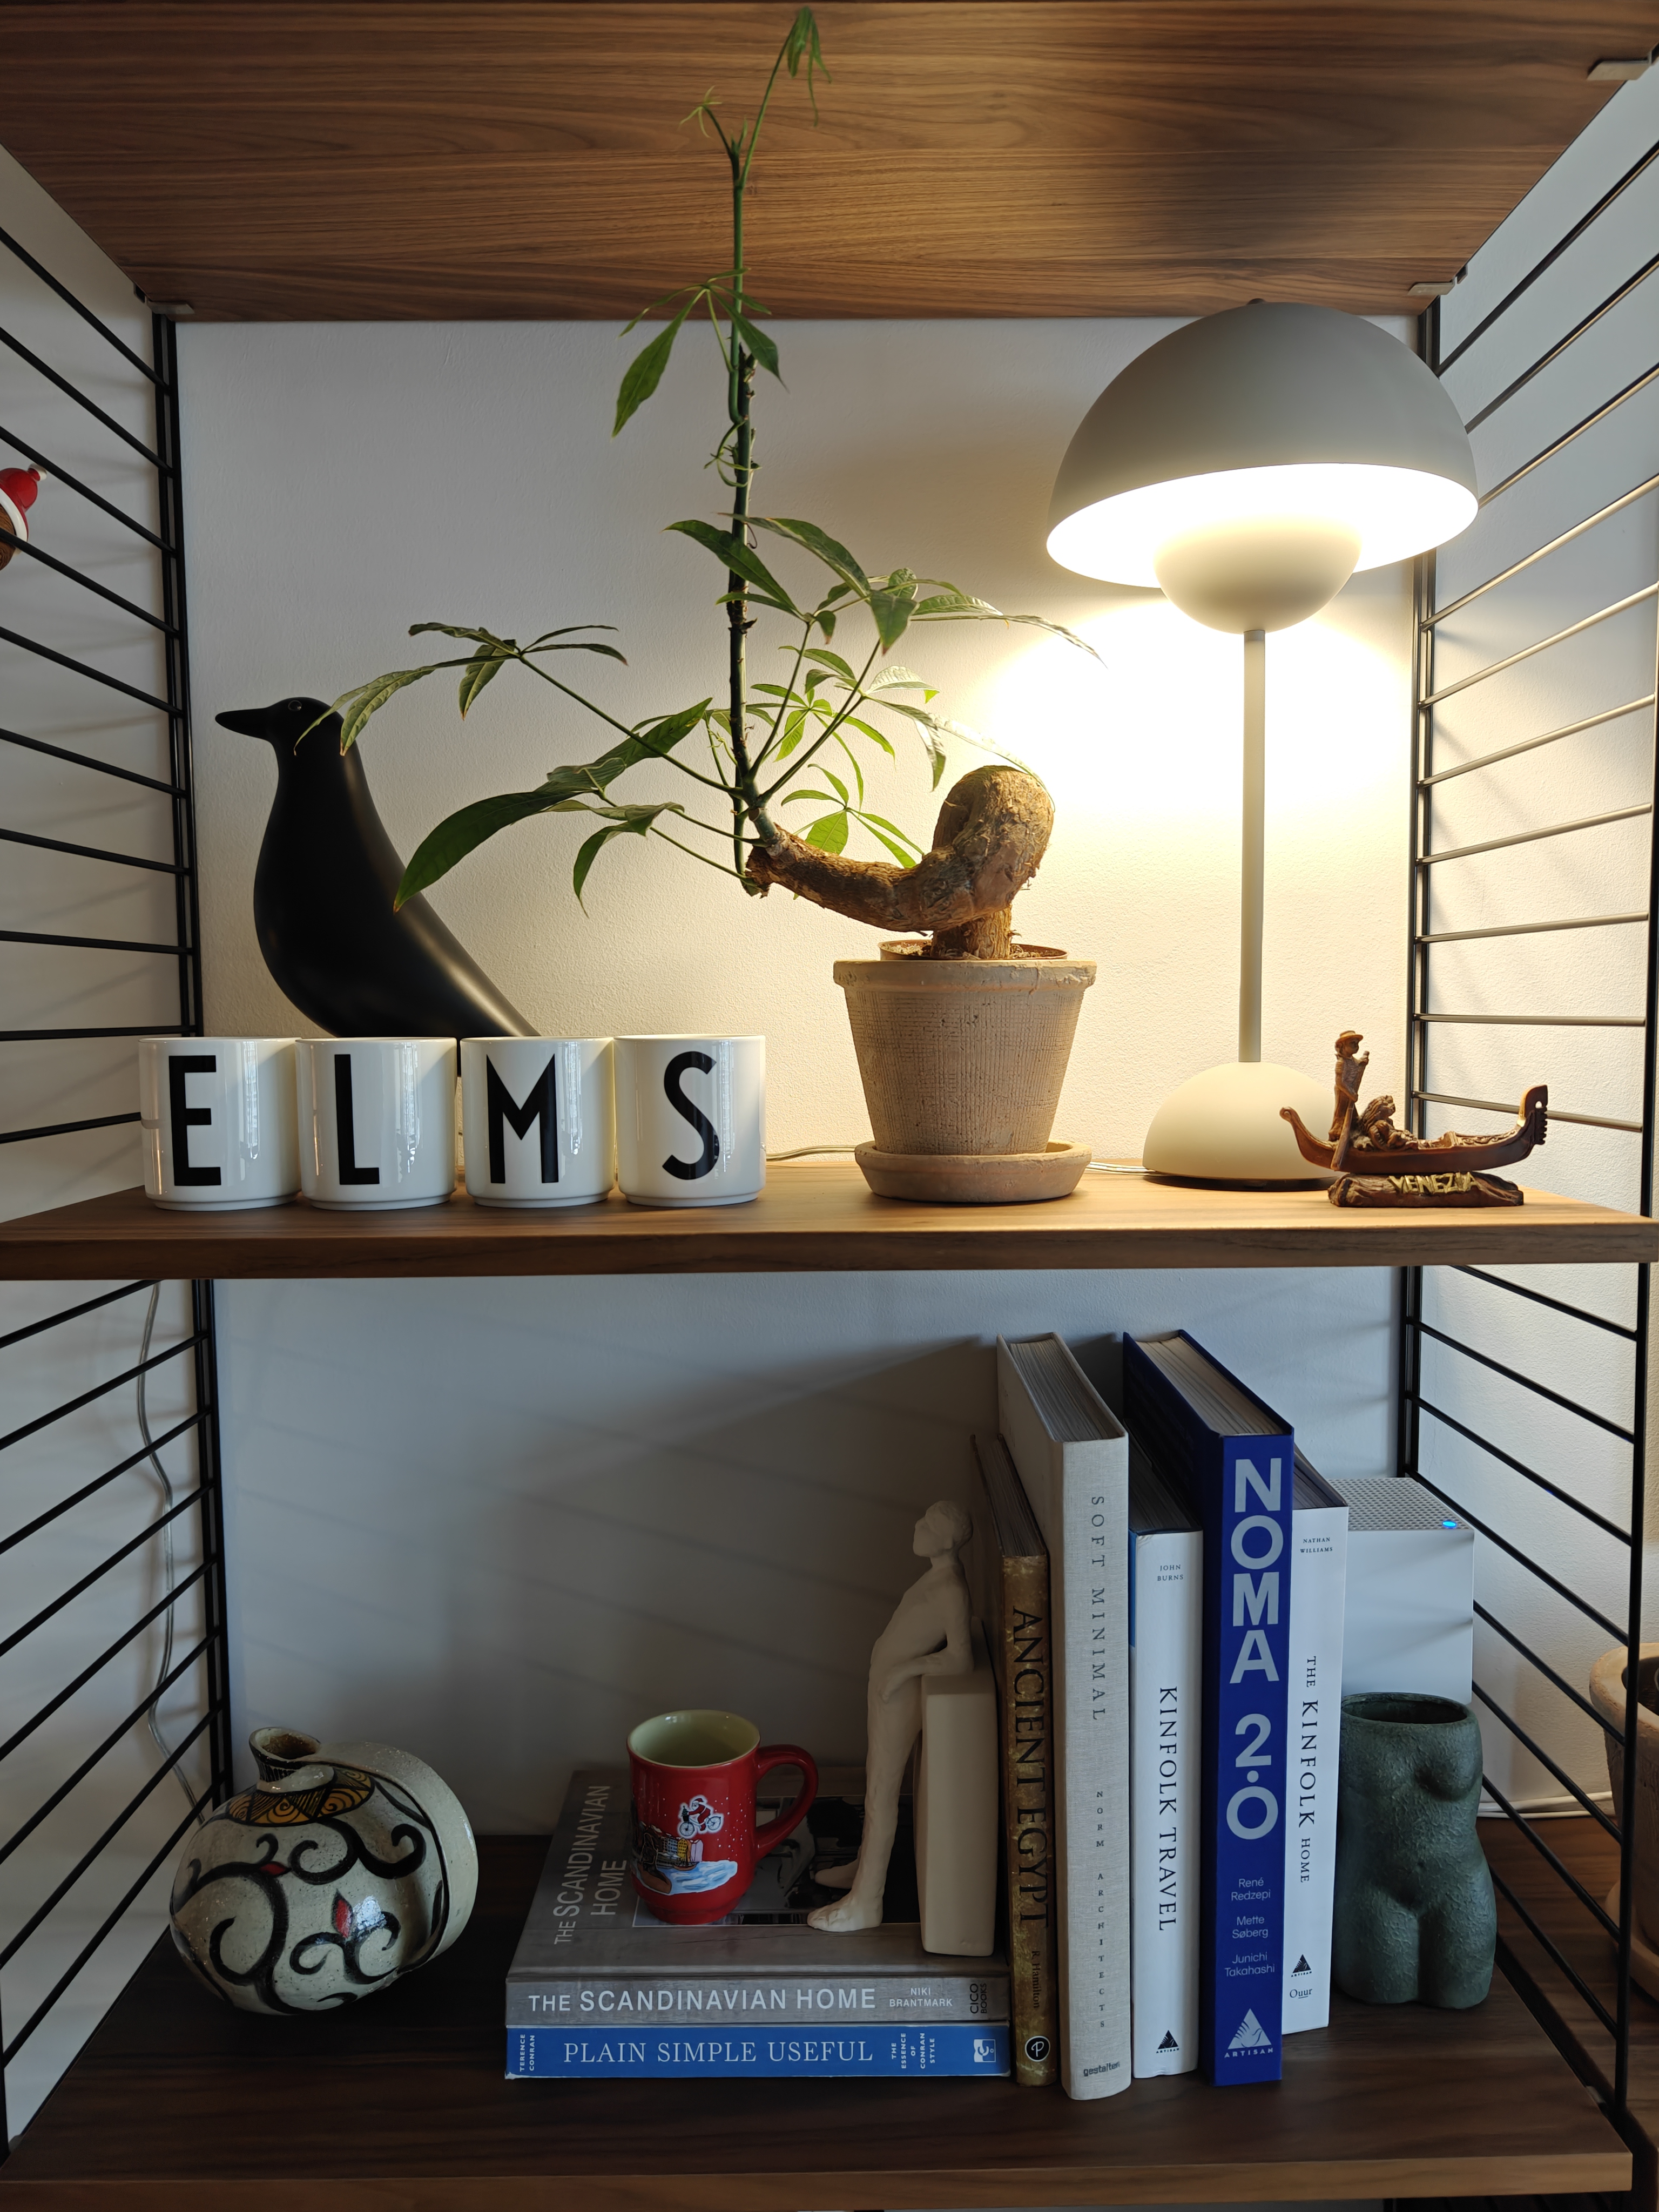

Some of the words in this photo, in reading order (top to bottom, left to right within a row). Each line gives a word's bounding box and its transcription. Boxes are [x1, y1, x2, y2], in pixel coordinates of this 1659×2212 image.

[169, 1055, 221, 1186] E
[335, 1054, 380, 1185] L
[486, 1054, 559, 1183] M
[663, 1051, 719, 1180] S
[1387, 1171, 1481, 1194] VENEZIA
[1091, 1496, 1104, 1566] SOFT
[1230, 1458, 1283, 1683] NOMA
[1091, 1588, 1105, 1720] MINIMAL
[1306, 1656, 1317, 1688] THE
[1013, 1606, 1046, 1791] ANCIENT
[1159, 1686, 1177, 1815] KINFOLK
[1299, 1700, 1318, 1827] KINFOLK
[1096, 1791, 1104, 1847] NORM
[552, 1785, 611, 1917] SCANDINAVIAN
[1017, 1805, 1048, 1928] EGYPT
[1300, 1838, 1311, 1883] HOME
[590, 1860, 627, 1916] HOME
[1159, 1827, 1177, 1931] TRAVEL
[1231, 1889, 1271, 1901] Redzepi
[1239, 1877, 1264, 1888] René
[554, 1921, 576, 1945] THE
[1232, 1928, 1269, 1939] Søberg
[1237, 1916, 1265, 1926] Mette
[1224, 1964, 1275, 1977] Takahashi
[1232, 1951, 1268, 1964] Junichi
[528, 1995, 571, 2012] THE
[579, 1989, 786, 2012] SCANDINAVIAN
[797, 1988, 875, 2010] HOME
[910, 1987, 931, 1997] NIKI
[969, 1983, 980, 2014] CICO
[1031, 1963, 1042, 2008] Hamilton
[1290, 1989, 1313, 1999] Ouur
[889, 1999, 953, 2008] BRANTMARK
[564, 2042, 646, 2062] PLAIN
[657, 2041, 756, 2062] SIMPLE
[767, 2041, 873, 2061] USEFUL
[910, 2045, 916, 2056] OF
[1224, 2048, 1273, 2058] ARTISAN
[1083, 2061, 1121, 2077] gestalten
